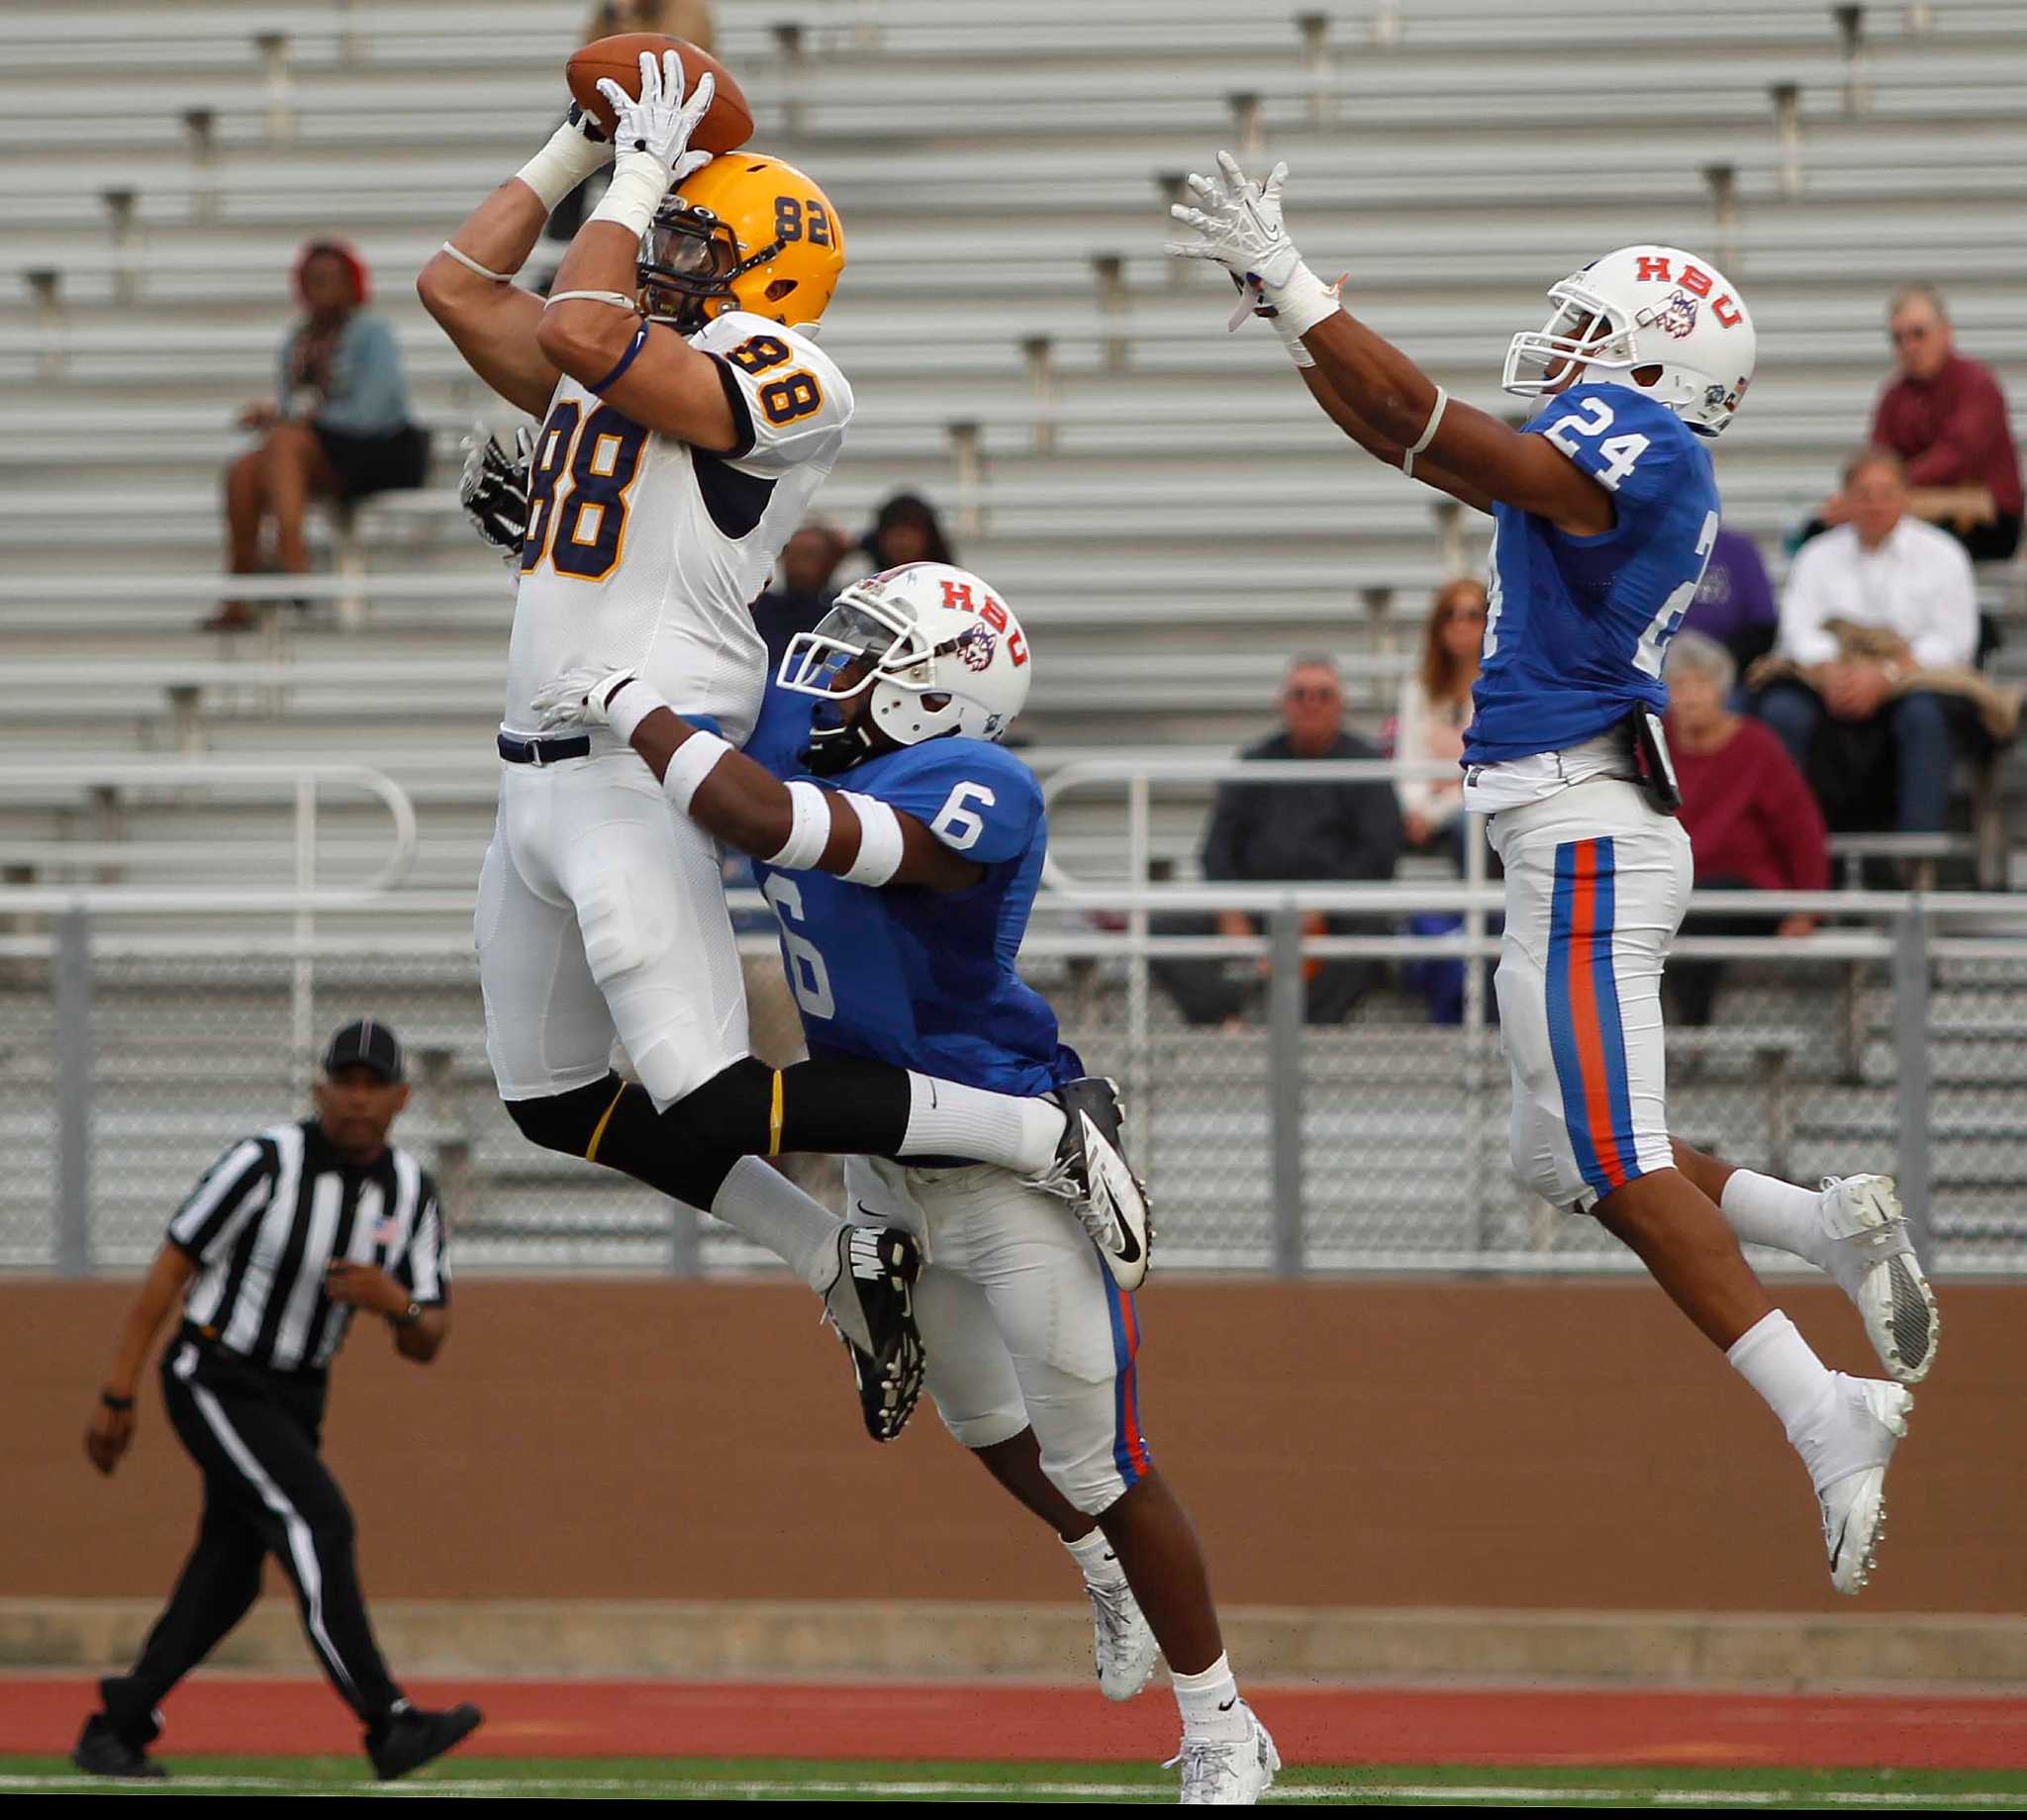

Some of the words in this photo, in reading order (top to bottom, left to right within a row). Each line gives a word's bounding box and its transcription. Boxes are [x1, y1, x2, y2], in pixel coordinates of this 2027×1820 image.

[774, 196, 829, 246] 82
[725, 334, 824, 429] 88
[520, 398, 653, 583] 88
[1544, 397, 1650, 491] 24
[929, 780, 997, 851] 6
[763, 872, 835, 1020] 6
